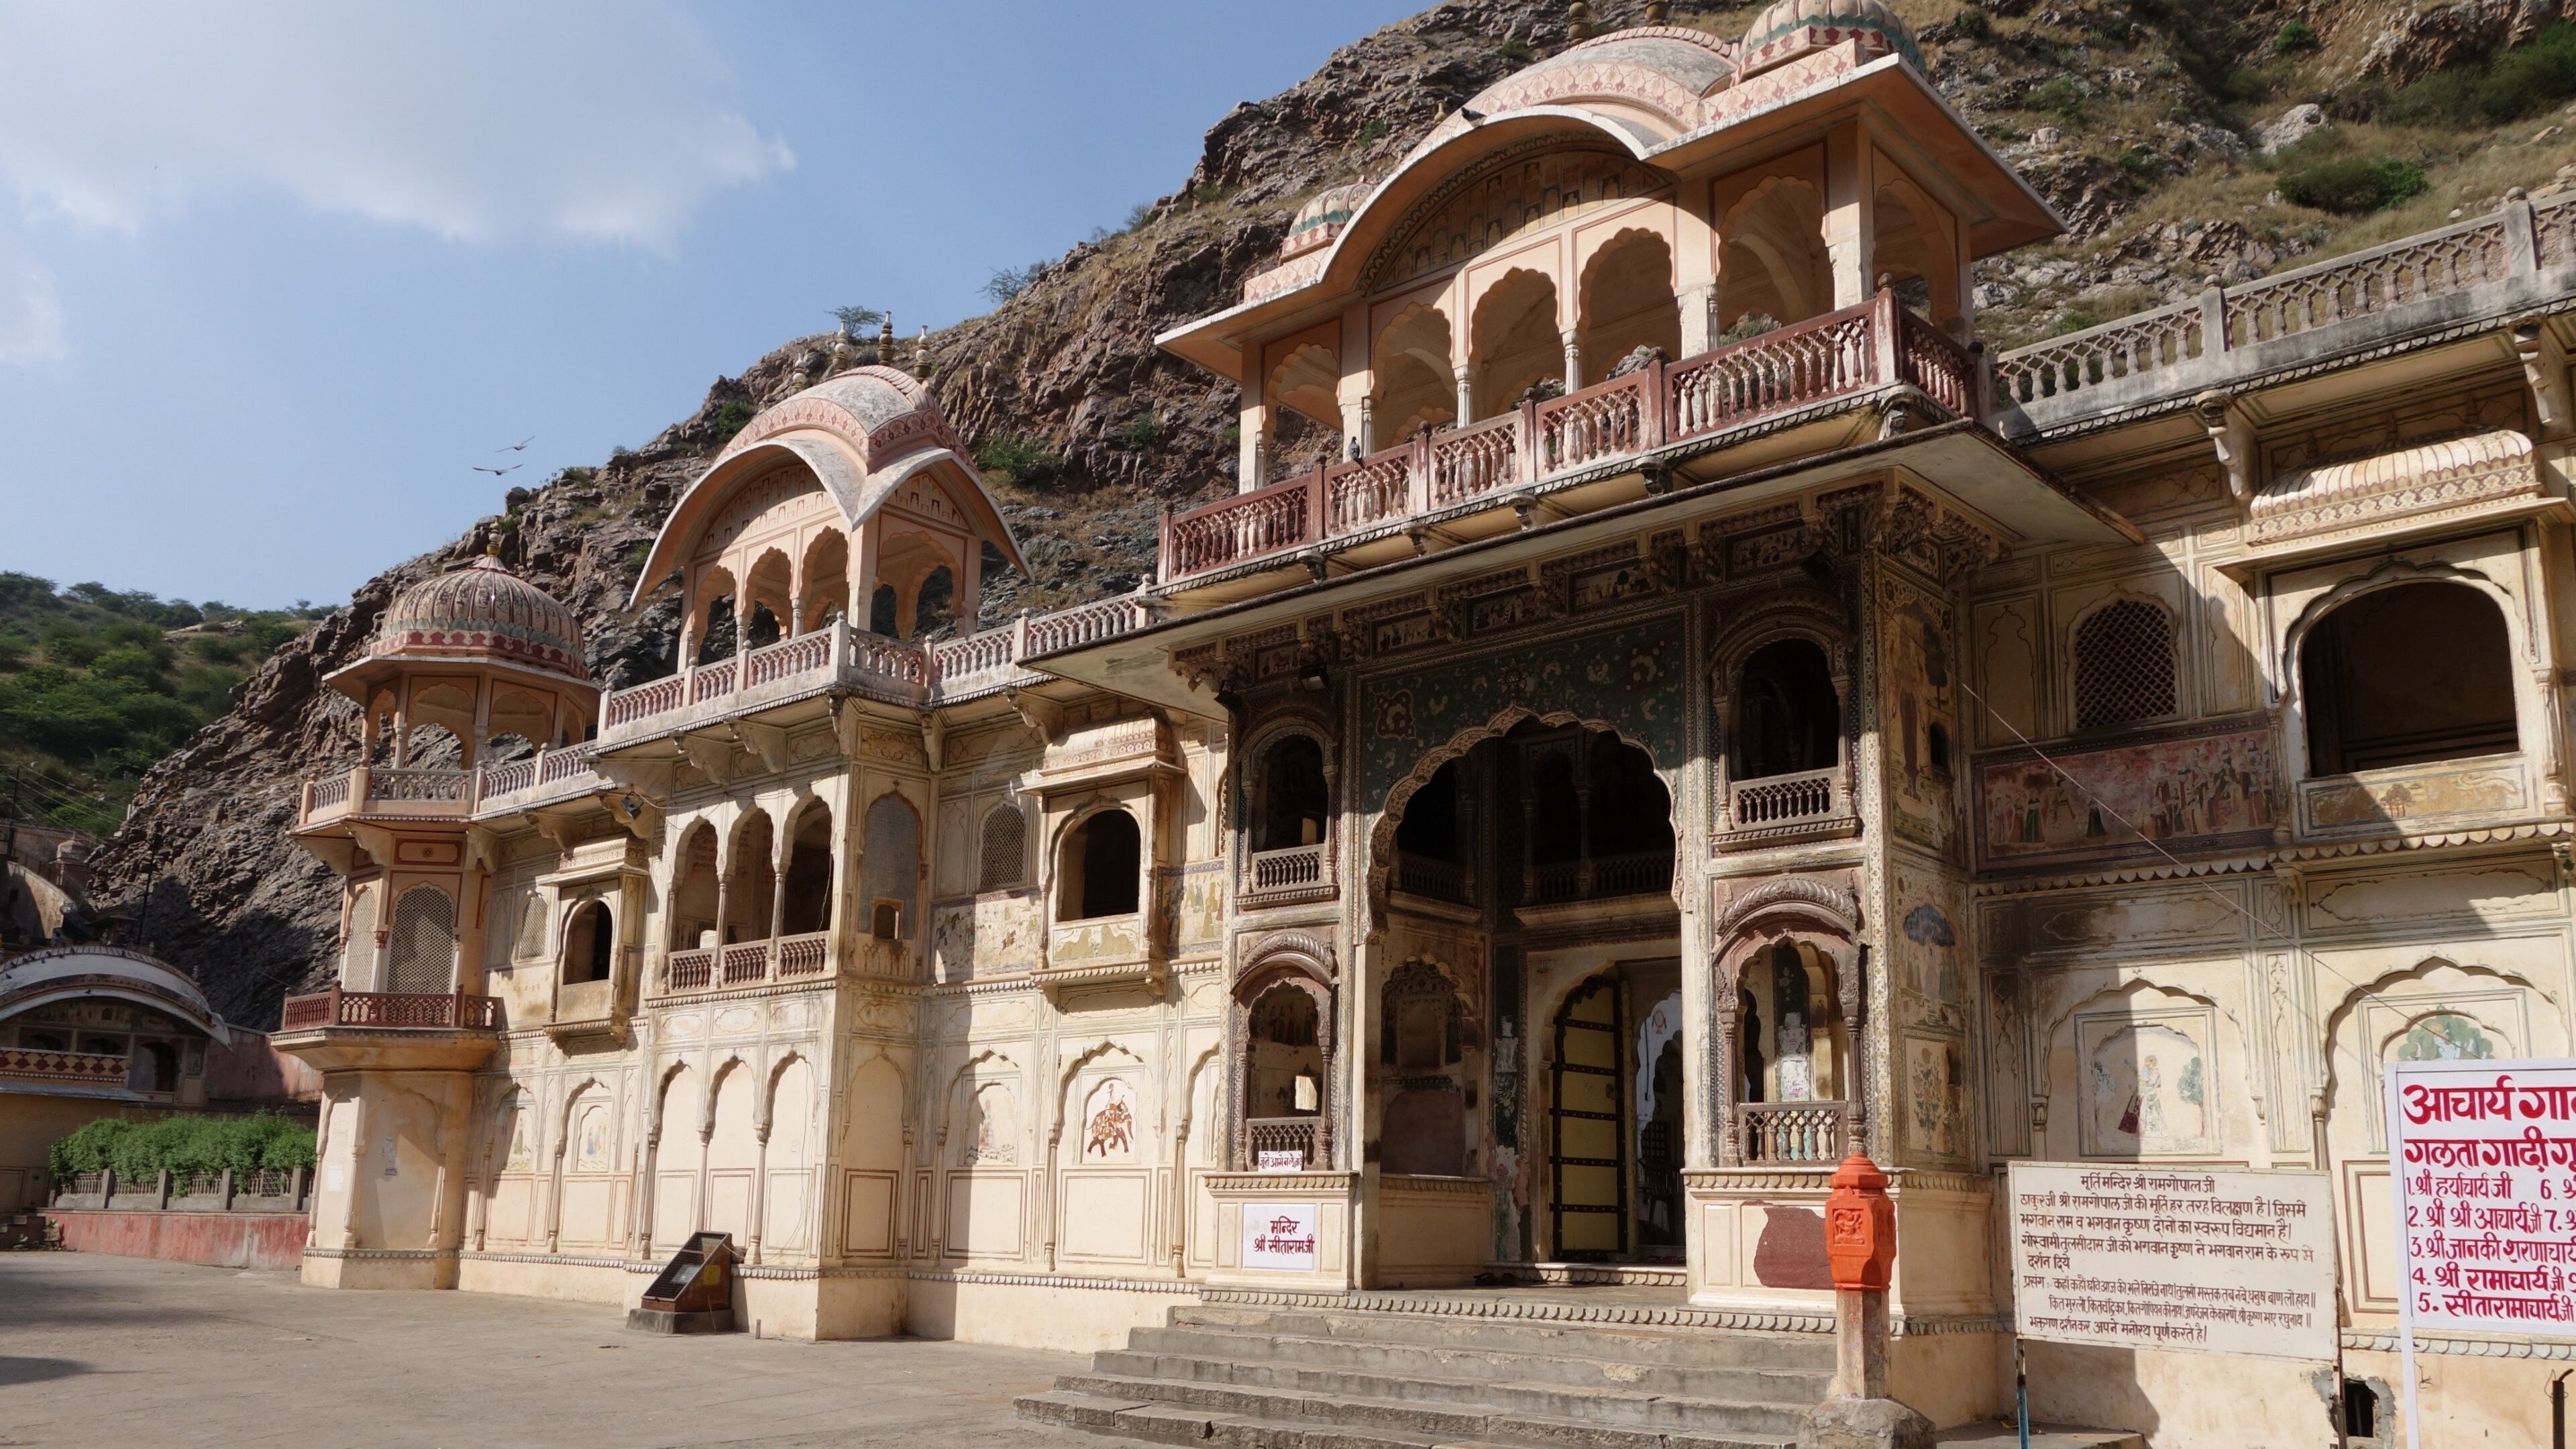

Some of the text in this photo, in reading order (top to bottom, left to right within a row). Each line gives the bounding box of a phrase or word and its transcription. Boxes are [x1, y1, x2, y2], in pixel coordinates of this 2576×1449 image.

[2402, 1075, 2576, 1124] आचार्य गा
[2403, 1138, 2481, 1170] गलता
[2481, 1126, 2549, 1173] गादी
[2080, 1172, 2101, 1192] मूर्ति
[2102, 1173, 2132, 1191] मन्दिर
[2133, 1175, 2146, 1191] श्री
[2491, 1171, 2514, 1199] जी
[2059, 1191, 2070, 1208] श्री
[2186, 1199, 2209, 1216] तरह
[2210, 1197, 2253, 1217] विलक्षण
[2426, 1197, 2446, 1228] श्री
[2450, 1200, 2473, 1228] श्री
[1270, 1216, 1300, 1235] मन्दिर
[2020, 1213, 2055, 1228] भगवान
[2056, 1215, 2073, 1230] राम
[2076, 1216, 2084, 1230] व
[2086, 1217, 2121, 1231] भगवान
[2122, 1218, 2150, 1236] कृष्ण
[2178, 1220, 2192, 1234] का
[2194, 1221, 2230, 1238] स्वरूप
[2232, 1219, 2275, 1238] विद्यमान
[1252, 1234, 1266, 1252] श्री
[2021, 1232, 2060, 1250] गोस्वामी
[2133, 1240, 2169, 1255] भगवान
[2169, 1242, 2193, 1258] कृष्ण
[2195, 1239, 2206, 1256] ने
[2208, 1244, 2243, 1260] भगवान
[2244, 1246, 2264, 1261] राम
[2265, 1242, 2277, 1260] के
[2279, 1248, 2300, 1263] रूप
[2426, 1230, 2446, 1260] श्री
[2446, 1232, 2502, 1260] जानकी
[2027, 1251, 2070, 1272] दर्शन दिये
[2434, 1261, 2461, 1289] श्री
[2093, 1318, 2119, 1334] अपने
[2121, 1320, 2151, 1339] मनोरथ
